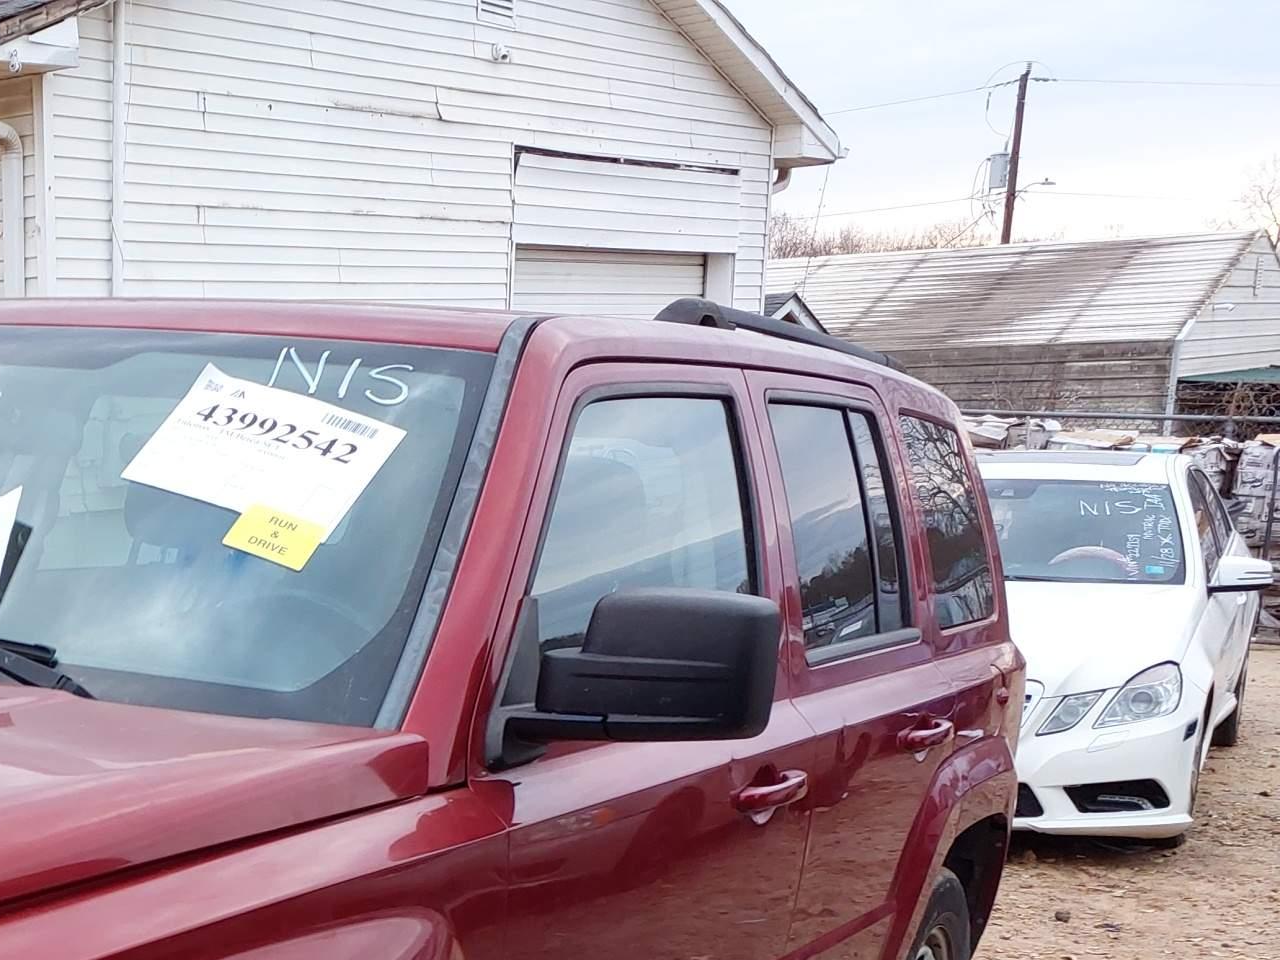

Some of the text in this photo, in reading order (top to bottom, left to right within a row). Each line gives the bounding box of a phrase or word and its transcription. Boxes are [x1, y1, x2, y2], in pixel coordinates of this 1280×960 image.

[269, 346, 415, 405] NIS
[196, 403, 359, 464] 43992542
[268, 515, 298, 532] RUN
[247, 535, 288, 556] DRIVE
[270, 530, 280, 540] &
